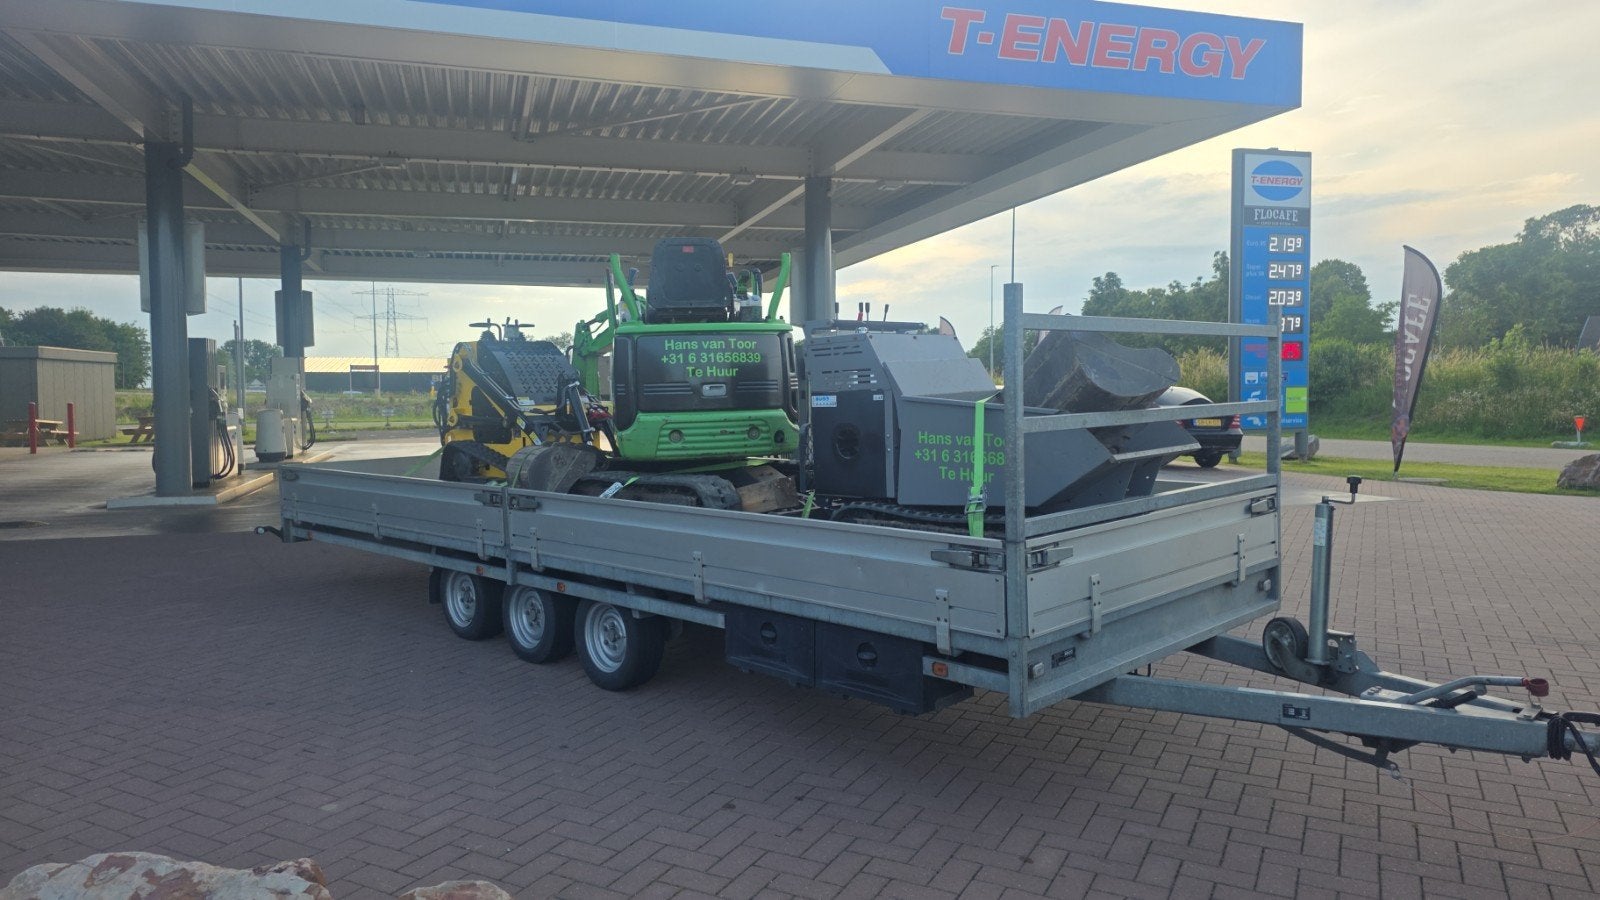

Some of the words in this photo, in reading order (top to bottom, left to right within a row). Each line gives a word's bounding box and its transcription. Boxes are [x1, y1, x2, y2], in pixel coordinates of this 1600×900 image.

[940, 6, 1267, 80] T-ENERGY
[1250, 175, 1303, 186] T-ENERGY
[1254, 208, 1298, 222] FLOCAFE
[664, 339, 698, 350] Hans
[702, 340, 725, 349] van
[728, 338, 757, 349] Toor
[661, 353, 683, 364] +31
[688, 353, 696, 363] 6
[700, 352, 761, 363] 31656839
[686, 367, 703, 377] Te
[706, 366, 739, 377] Huur
[918, 431, 952, 445] Hans
[984, 433, 1006, 447] To
[914, 448, 937, 462] +31
[941, 449, 950, 462] 6
[939, 466, 956, 480] Te
